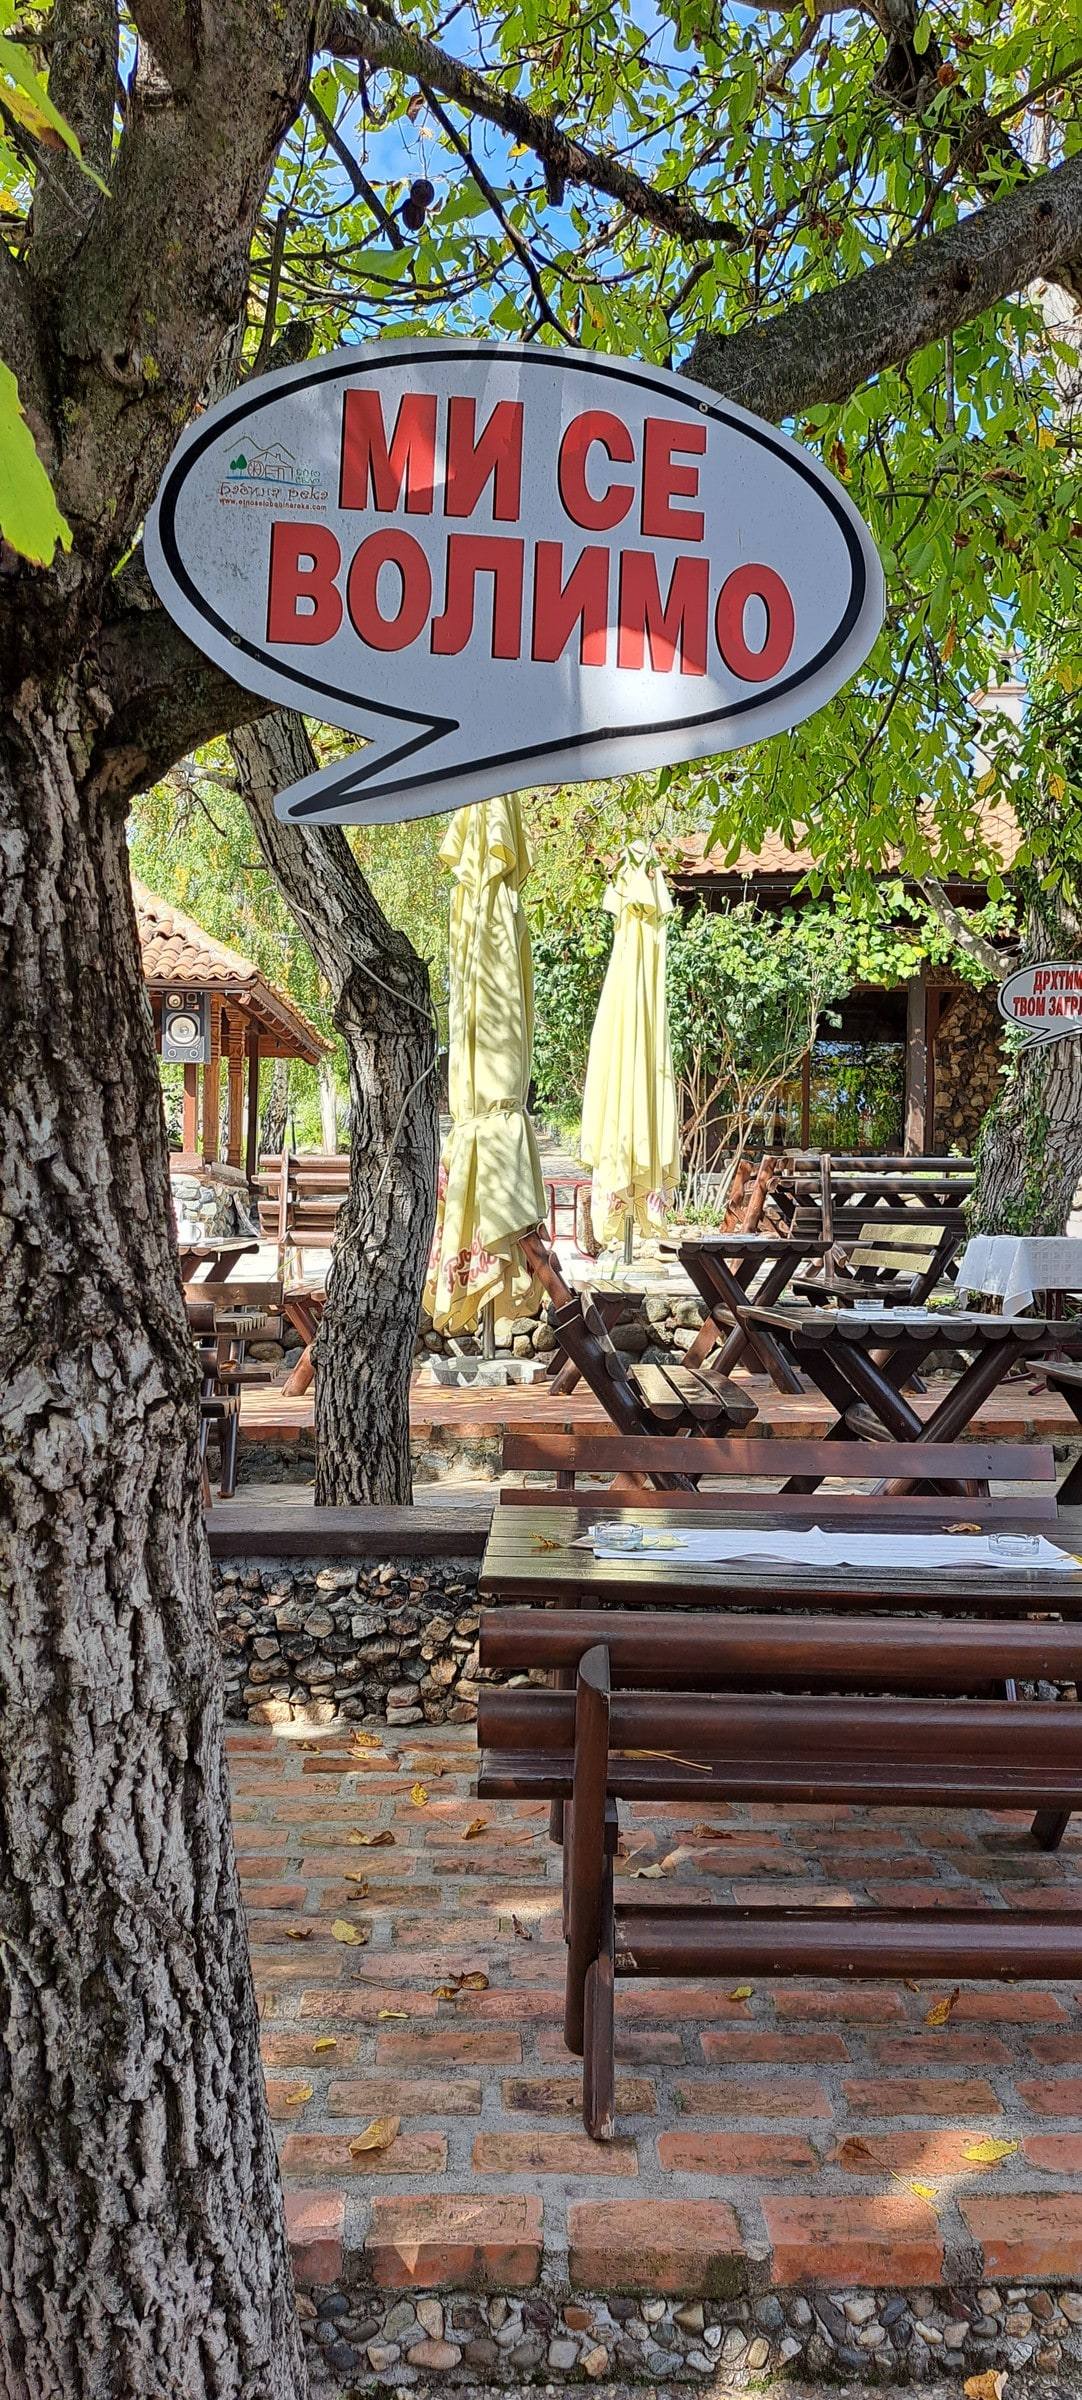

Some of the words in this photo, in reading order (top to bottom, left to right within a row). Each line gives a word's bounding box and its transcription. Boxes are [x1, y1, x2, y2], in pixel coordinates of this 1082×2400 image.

[340, 389, 524, 521] МИ
[558, 410, 706, 542] СЕ
[266, 521, 796, 683] ВОЛИМО
[1012, 996, 1046, 1016] ТВОМ
